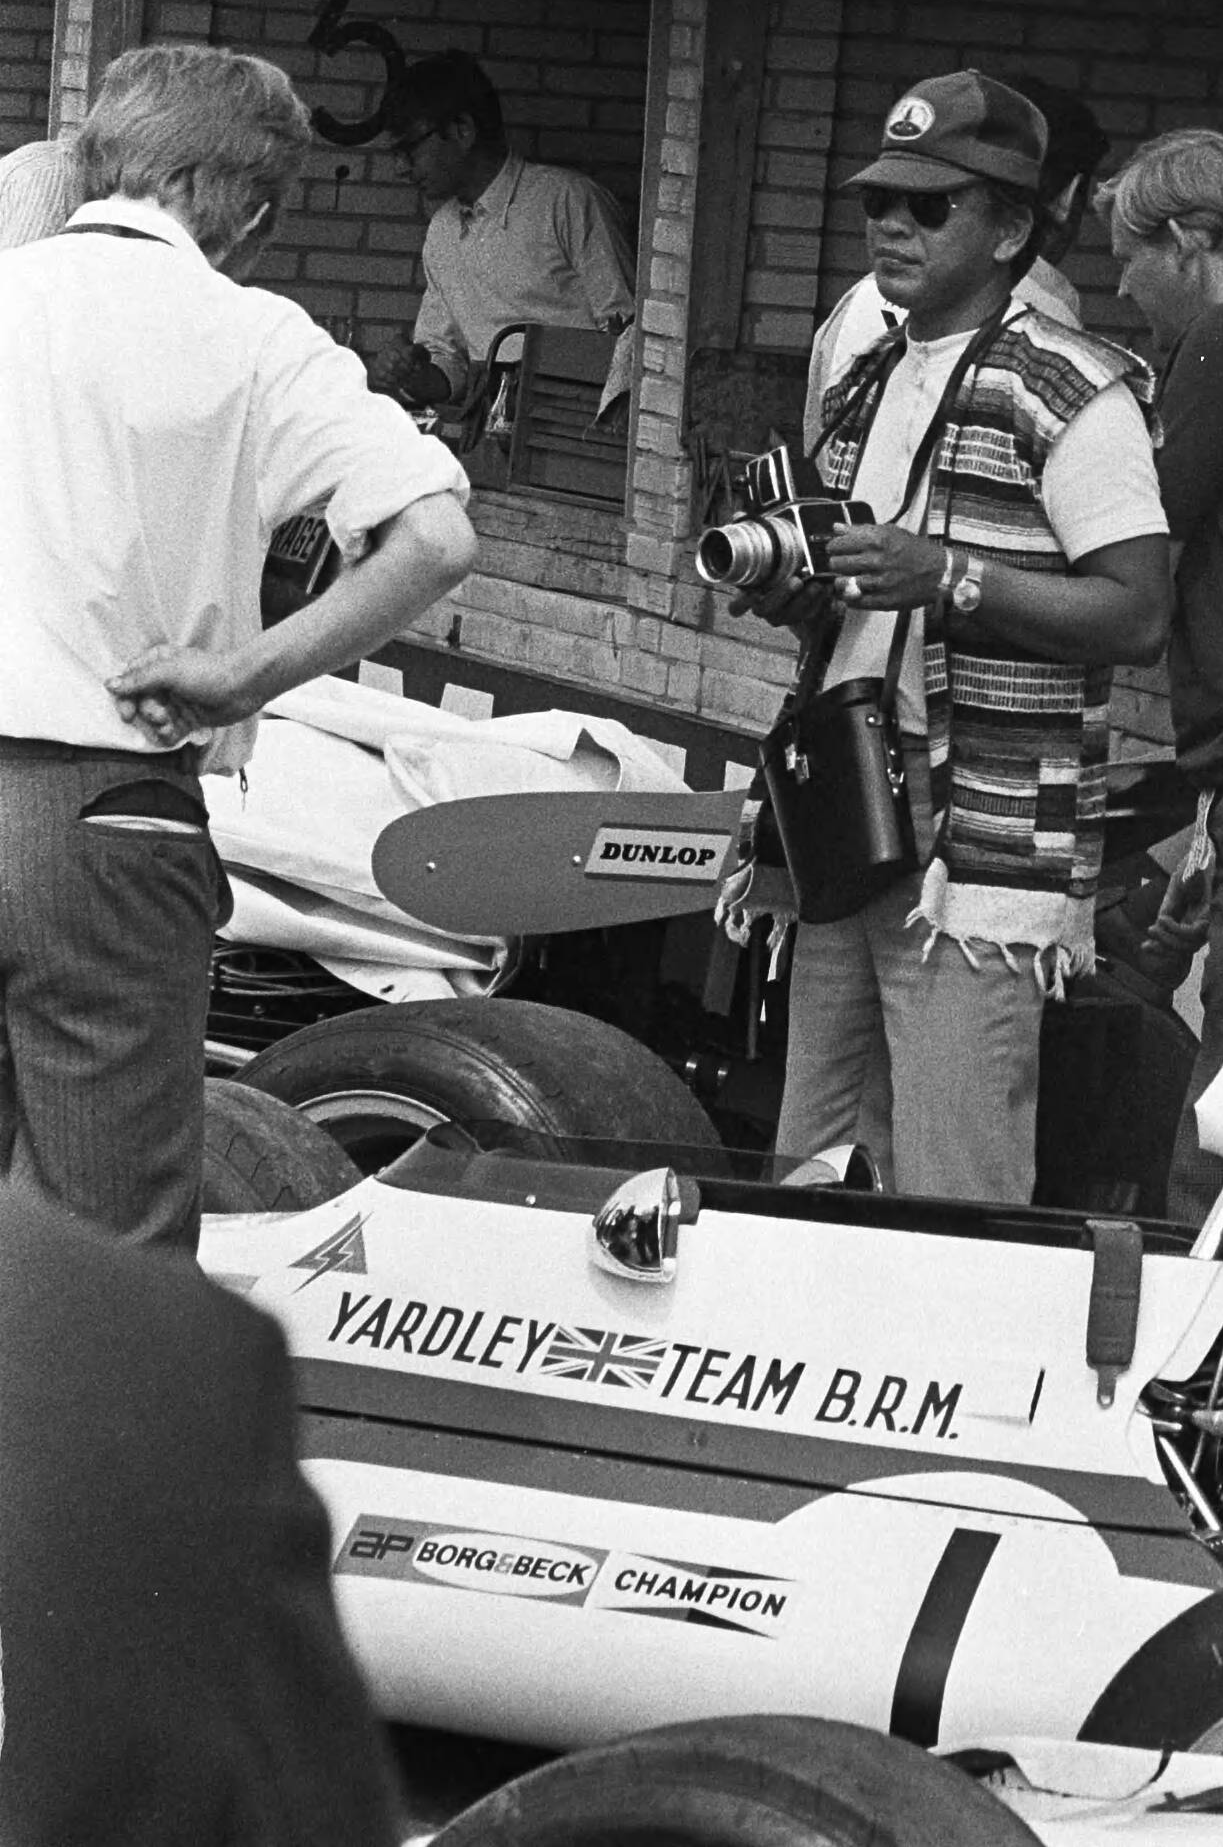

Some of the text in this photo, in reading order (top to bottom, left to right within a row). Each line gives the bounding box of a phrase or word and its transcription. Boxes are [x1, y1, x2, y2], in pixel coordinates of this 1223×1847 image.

[599, 841, 716, 866] DUNLOP
[328, 1292, 963, 1439] YARDLEY TEAM B.R.M.
[615, 1569, 786, 1617] CHAMPION
